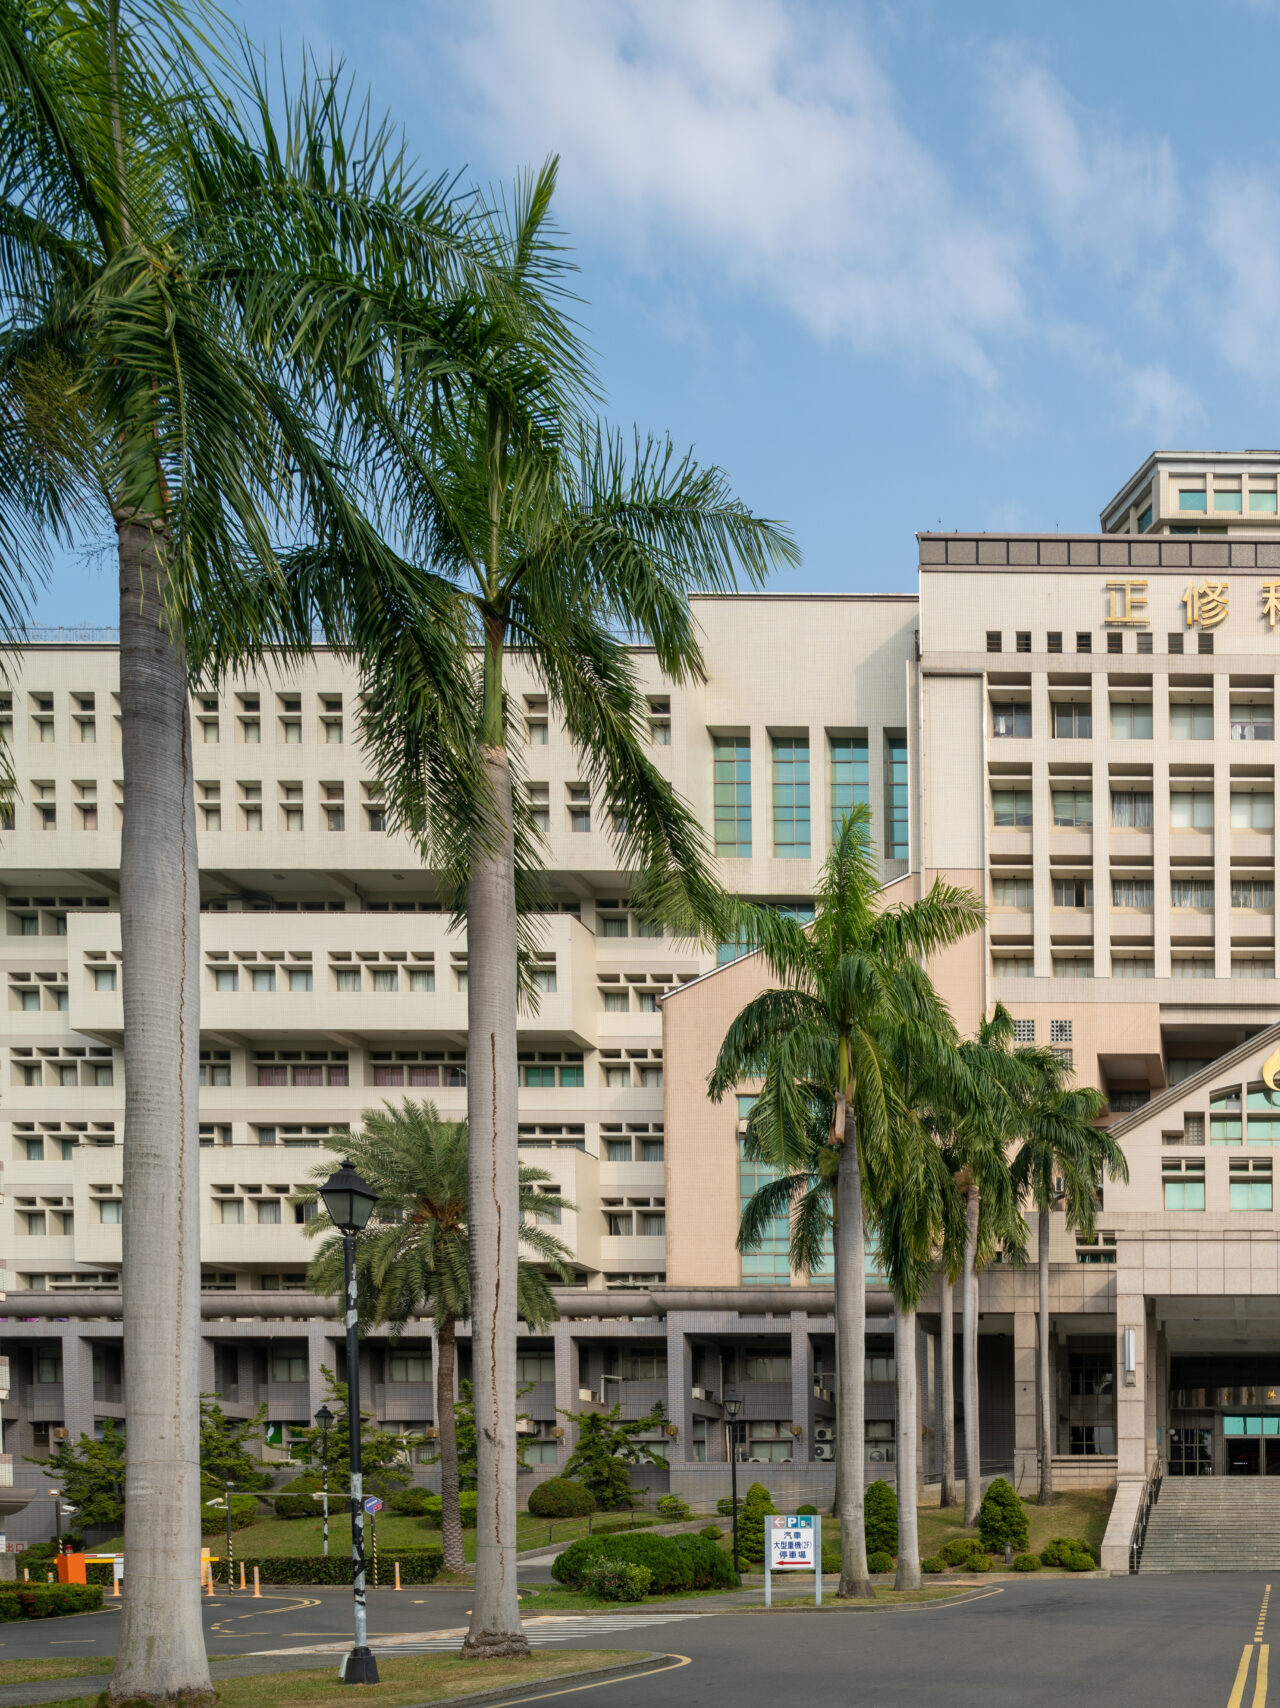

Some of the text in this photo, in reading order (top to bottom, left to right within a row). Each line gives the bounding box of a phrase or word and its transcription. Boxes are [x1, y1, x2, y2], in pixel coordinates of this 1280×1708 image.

[788, 1517, 797, 1527] P
[784, 1532, 801, 1540] 汽車
[6, 1543, 24, 1552] 出口
[780, 1551, 806, 1559] 停車場
